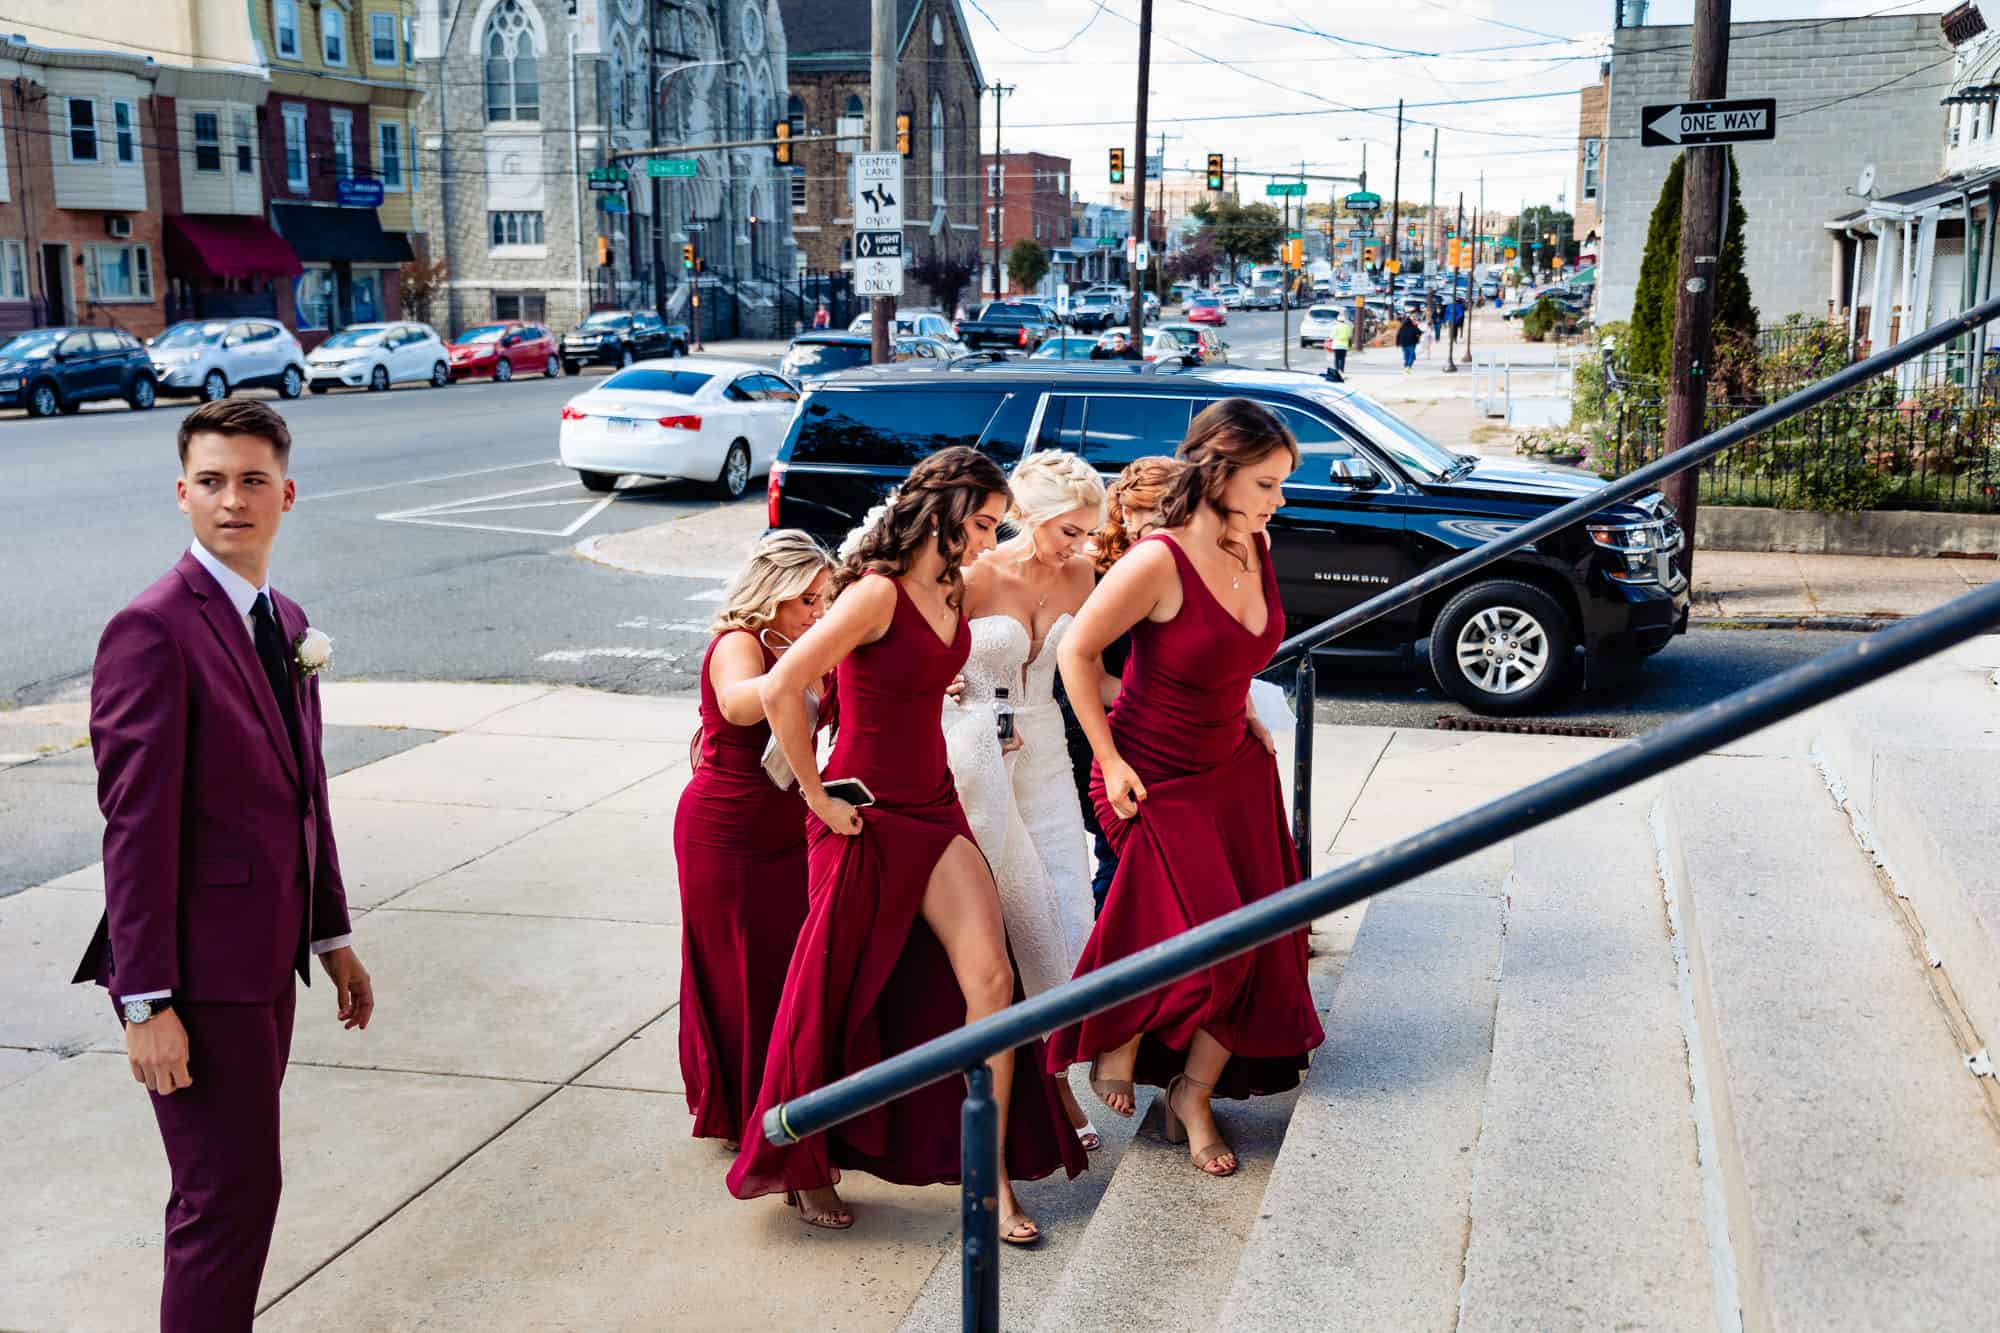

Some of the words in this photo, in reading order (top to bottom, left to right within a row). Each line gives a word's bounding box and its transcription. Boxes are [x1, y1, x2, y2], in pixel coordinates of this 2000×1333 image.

[1680, 115, 1717, 132] ONE
[1724, 111, 1761, 129] WAY
[859, 158, 897, 168] CENTER
[865, 167, 891, 176] LANE
[865, 216, 892, 225] ONLY
[875, 234, 900, 244] RIGHT
[876, 246, 899, 255] LANE
[864, 279, 894, 291] ONLY
[1314, 572, 1389, 584] SUBURBAN
